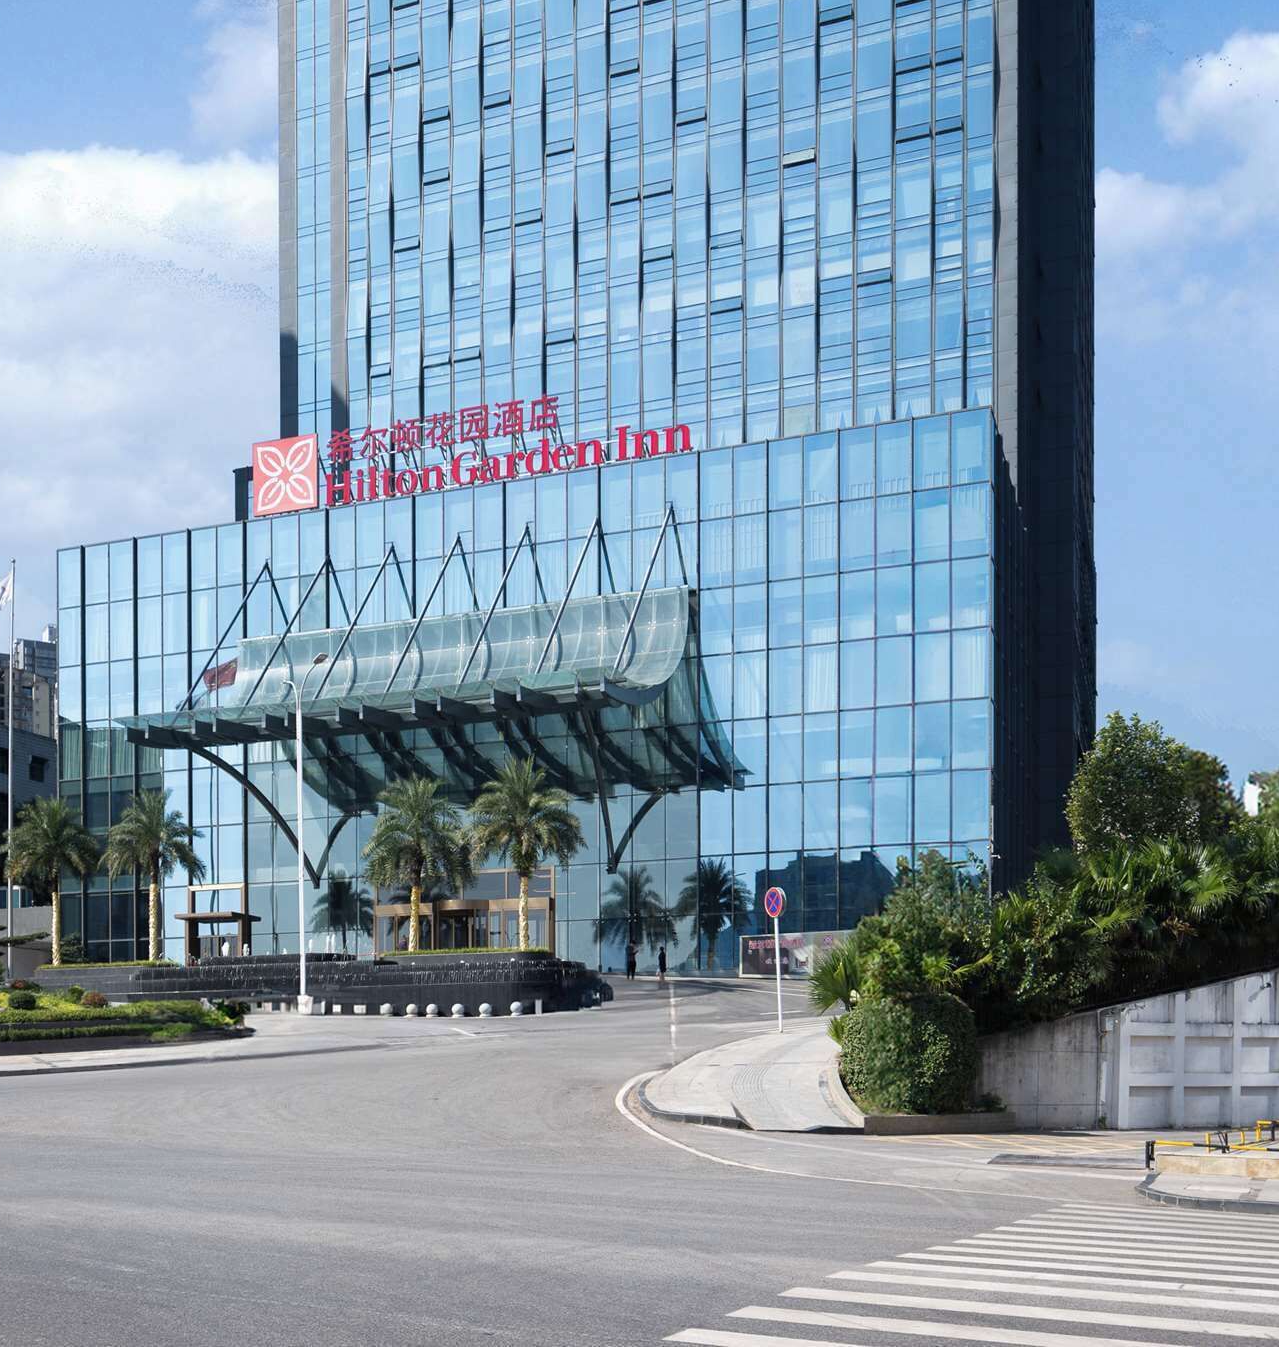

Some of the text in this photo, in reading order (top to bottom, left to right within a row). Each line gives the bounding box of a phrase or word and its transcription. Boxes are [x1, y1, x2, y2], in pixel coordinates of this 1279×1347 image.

[325, 423, 694, 506] Hilton Garden Inn
[327, 395, 558, 464] 希尔顿花园酒店
